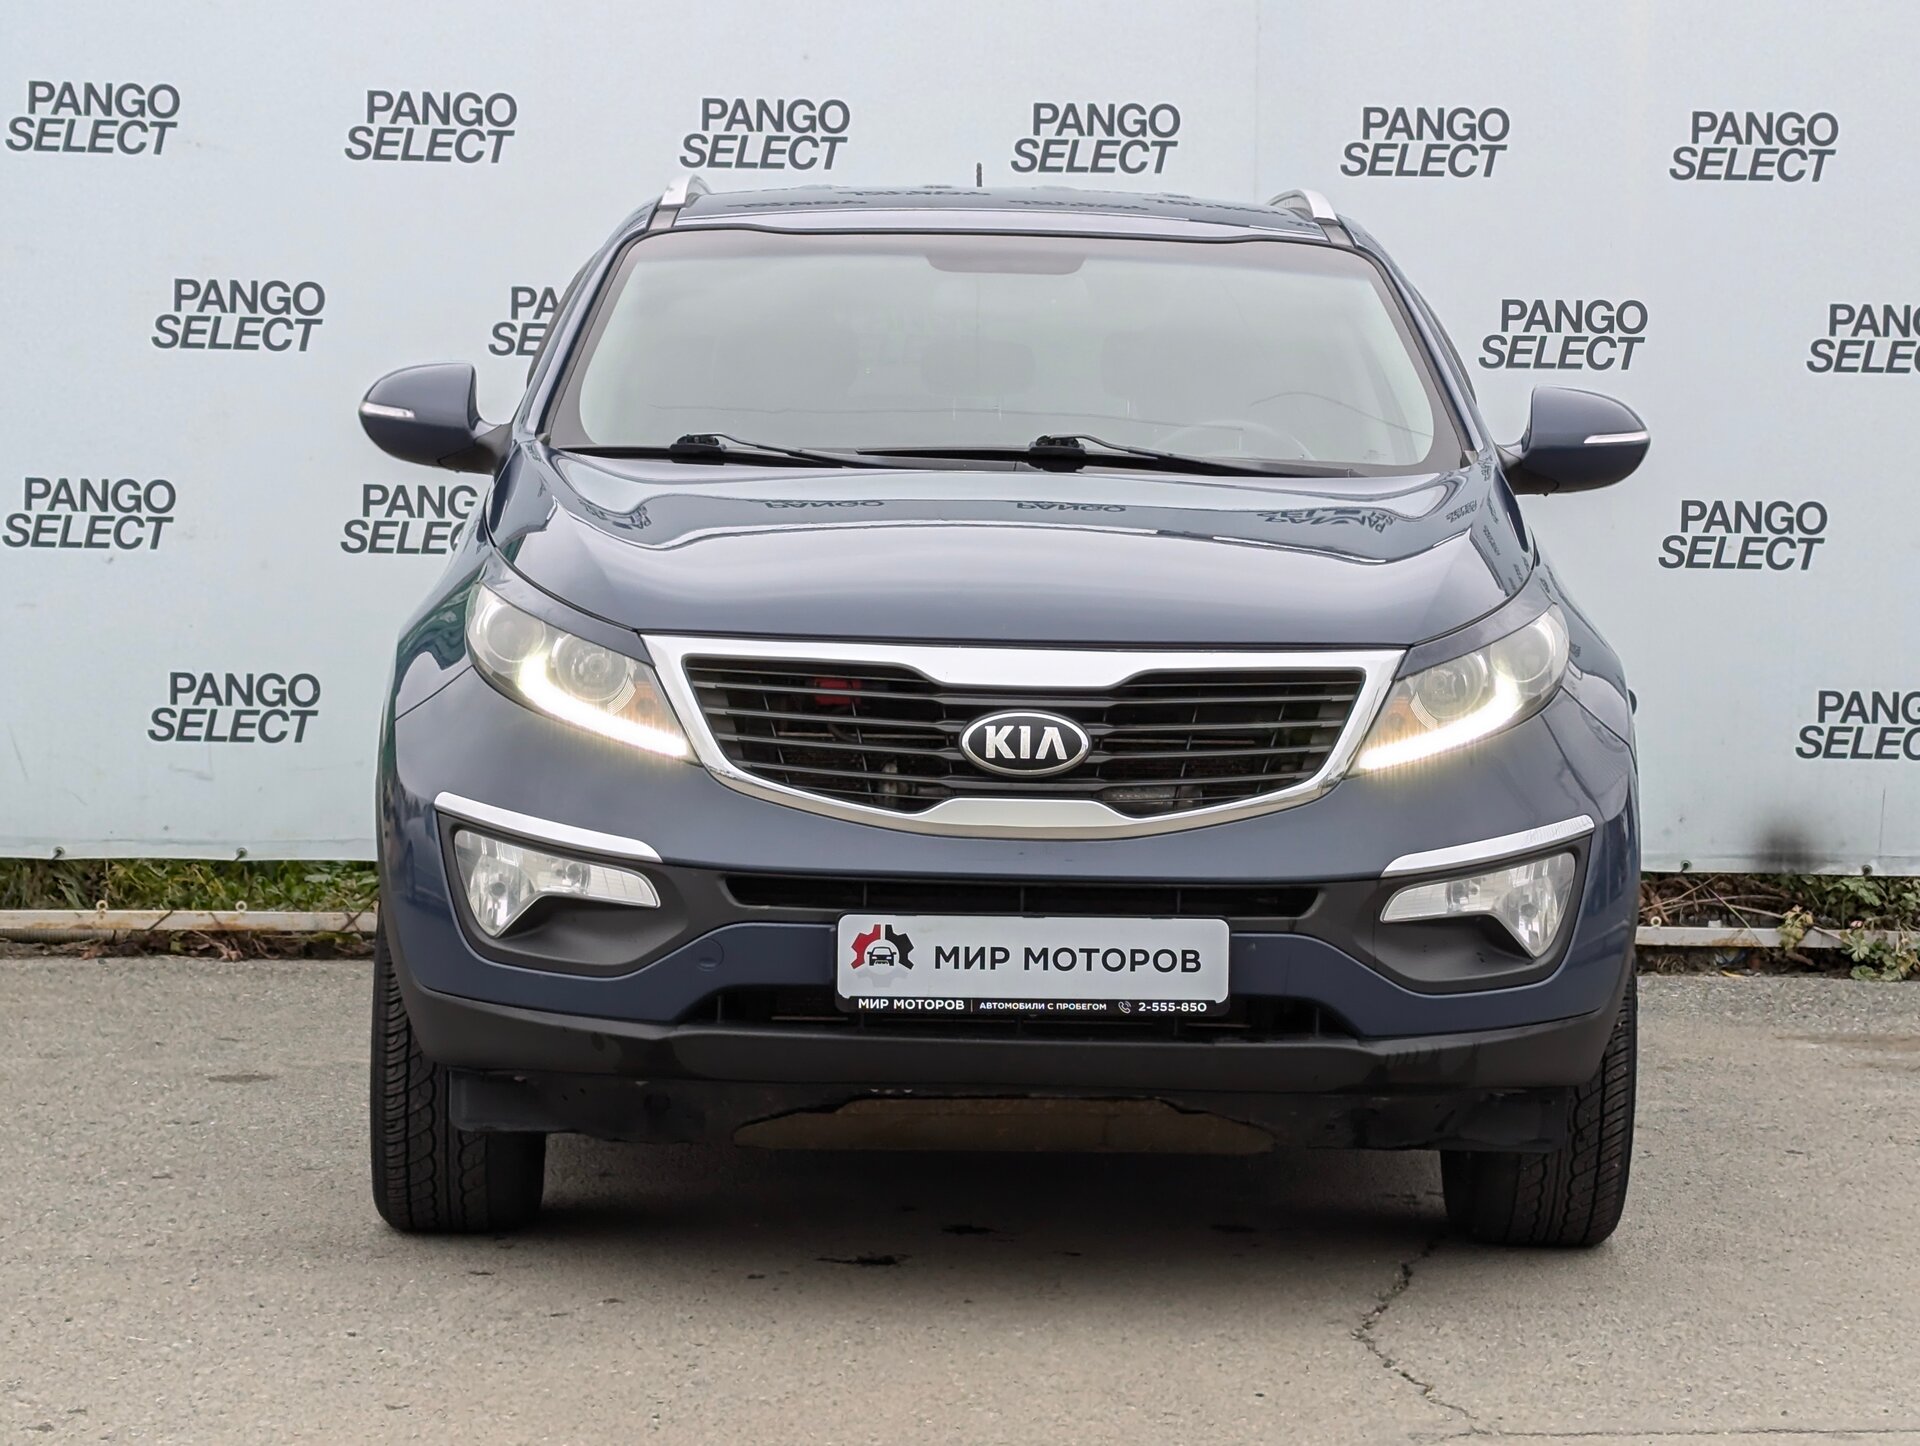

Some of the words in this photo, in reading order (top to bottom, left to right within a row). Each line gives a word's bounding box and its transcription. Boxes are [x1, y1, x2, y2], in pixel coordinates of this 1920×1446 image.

[29, 81, 179, 118] PANGO
[367, 91, 517, 127] PANGO
[702, 99, 849, 133] PANGO
[6, 117, 177, 155] SELECT
[1034, 103, 1180, 138] PANGO
[1363, 107, 1509, 142] PANGO
[1692, 112, 1838, 146] PANGO
[345, 126, 514, 163] SELECT
[680, 134, 847, 169] SELECT
[1011, 138, 1178, 174] SELECT
[1341, 142, 1507, 177] SELECT
[1670, 147, 1836, 182] SELECT
[174, 279, 325, 315] PANGO
[152, 315, 322, 352] SELECT
[1502, 300, 1647, 334] PANGO
[1479, 335, 1645, 370] SELECT
[1806, 338, 1920, 374] SELE
[24, 477, 176, 513] PANGO
[3, 513, 173, 550] SELECT
[1681, 501, 1827, 536] PANGO
[1659, 535, 1825, 570] SELECT
[170, 672, 320, 707] PANGO
[148, 708, 318, 743] SELECT
[985, 726, 1068, 760] KIA
[934, 946, 1010, 970] МИР
[1024, 947, 1202, 973] МОТОРОВ
[858, 999, 889, 1009] МИР
[893, 999, 965, 1010] МОТОРОВ
[979, 1001, 1045, 1010] АВТОМОБИЛИ
[1047, 1002, 1054, 1010] С
[1056, 1002, 1107, 1010] ПРОБЕГОМ
[1138, 1002, 1208, 1012] 2-555-850
